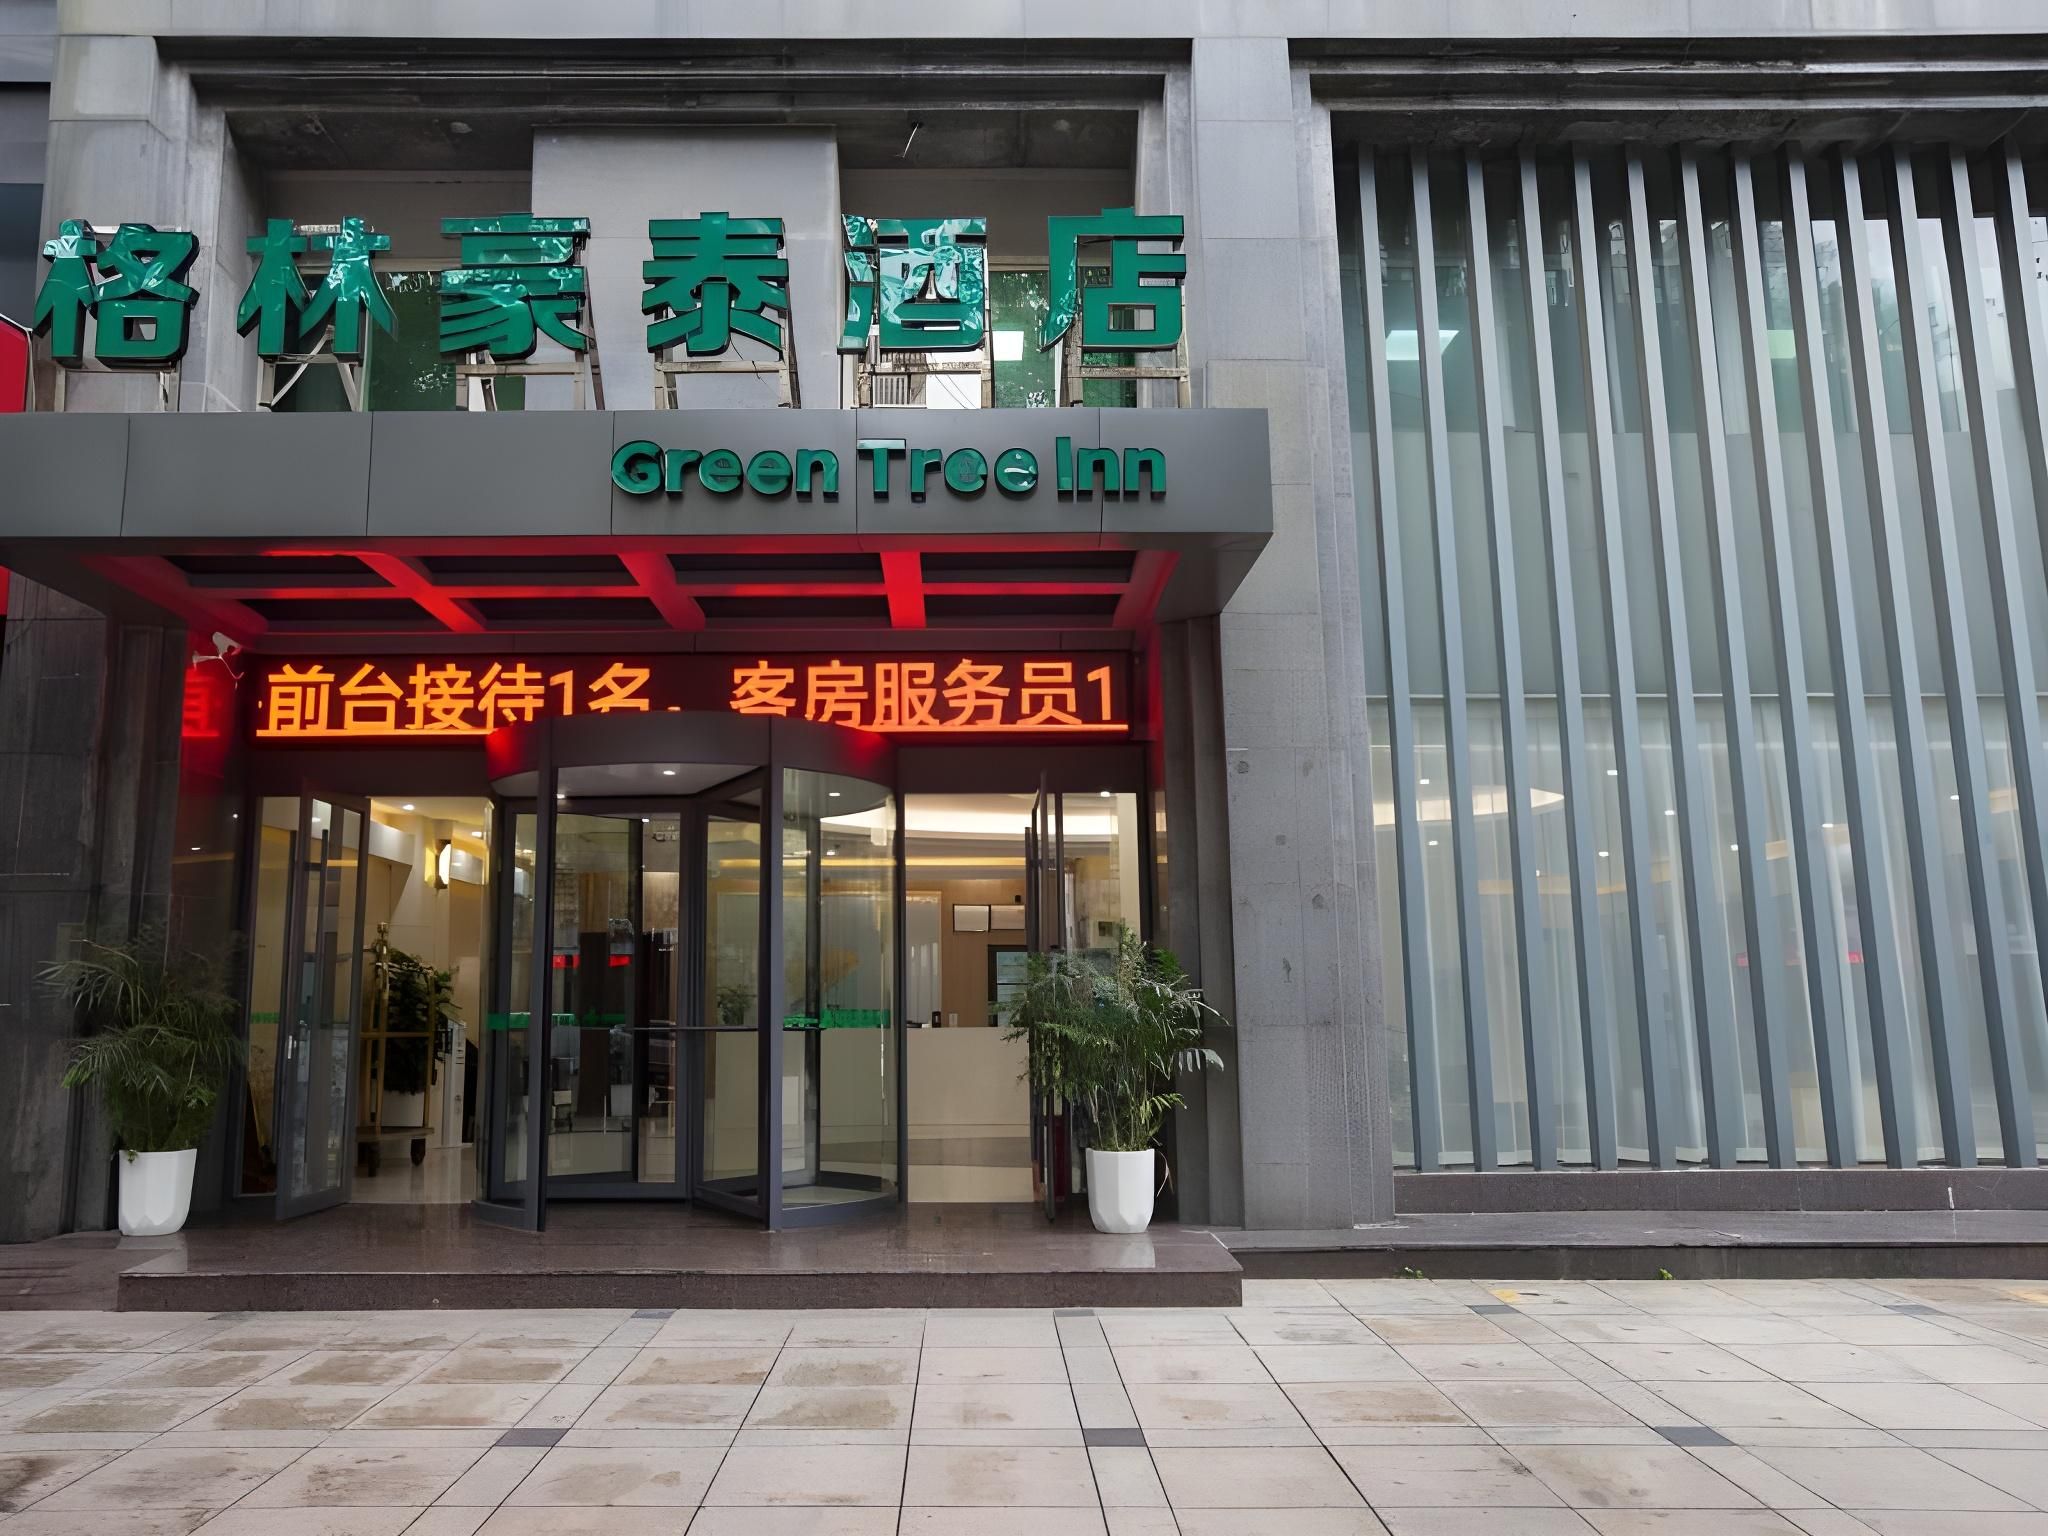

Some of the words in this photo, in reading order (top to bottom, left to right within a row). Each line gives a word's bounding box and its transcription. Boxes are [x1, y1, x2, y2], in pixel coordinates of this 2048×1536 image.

[33, 207, 1187, 366] 格林豪泰酒店
[611, 440, 840, 496] Green
[857, 438, 1039, 496] Tree
[1055, 436, 1168, 496] Inn
[266, 661, 682, 730] 前台接待1名
